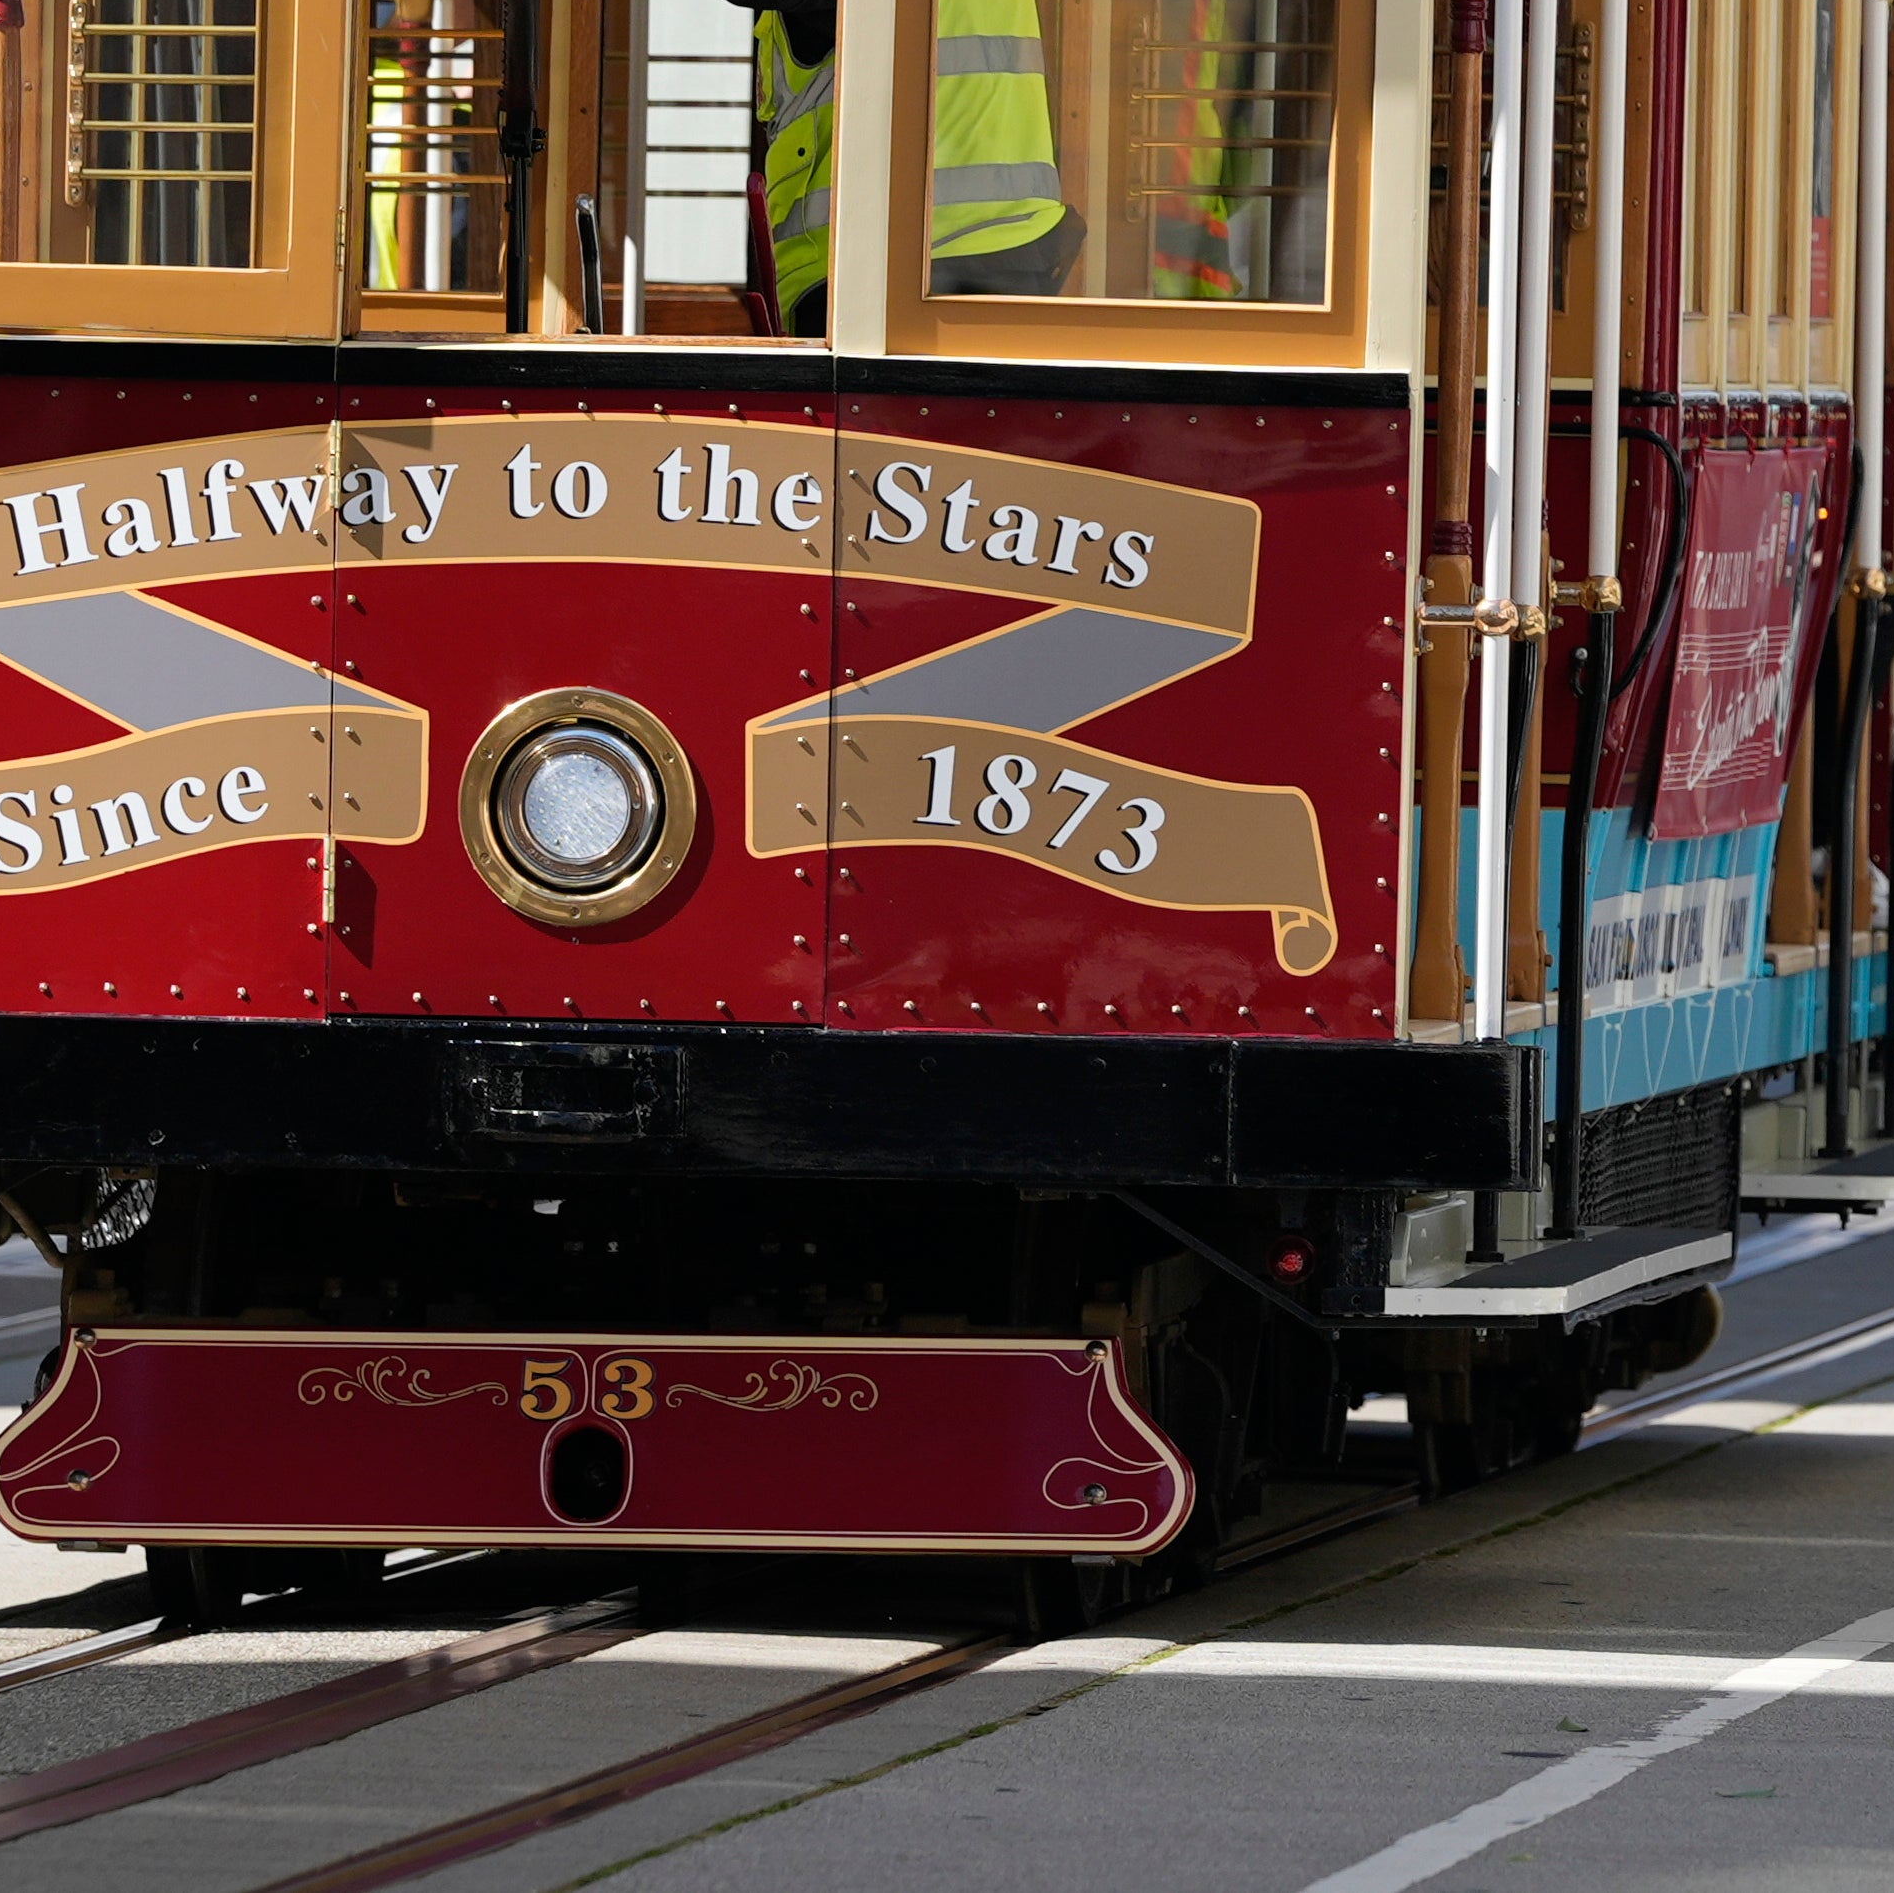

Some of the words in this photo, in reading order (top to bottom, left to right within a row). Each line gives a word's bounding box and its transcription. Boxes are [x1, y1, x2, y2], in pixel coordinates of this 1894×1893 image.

[1, 457, 461, 579] Halfway
[505, 441, 610, 521] to
[655, 442, 824, 534] the
[867, 460, 1157, 591] Stars
[914, 744, 1167, 876] 1873
[519, 1358, 655, 1421] 53
